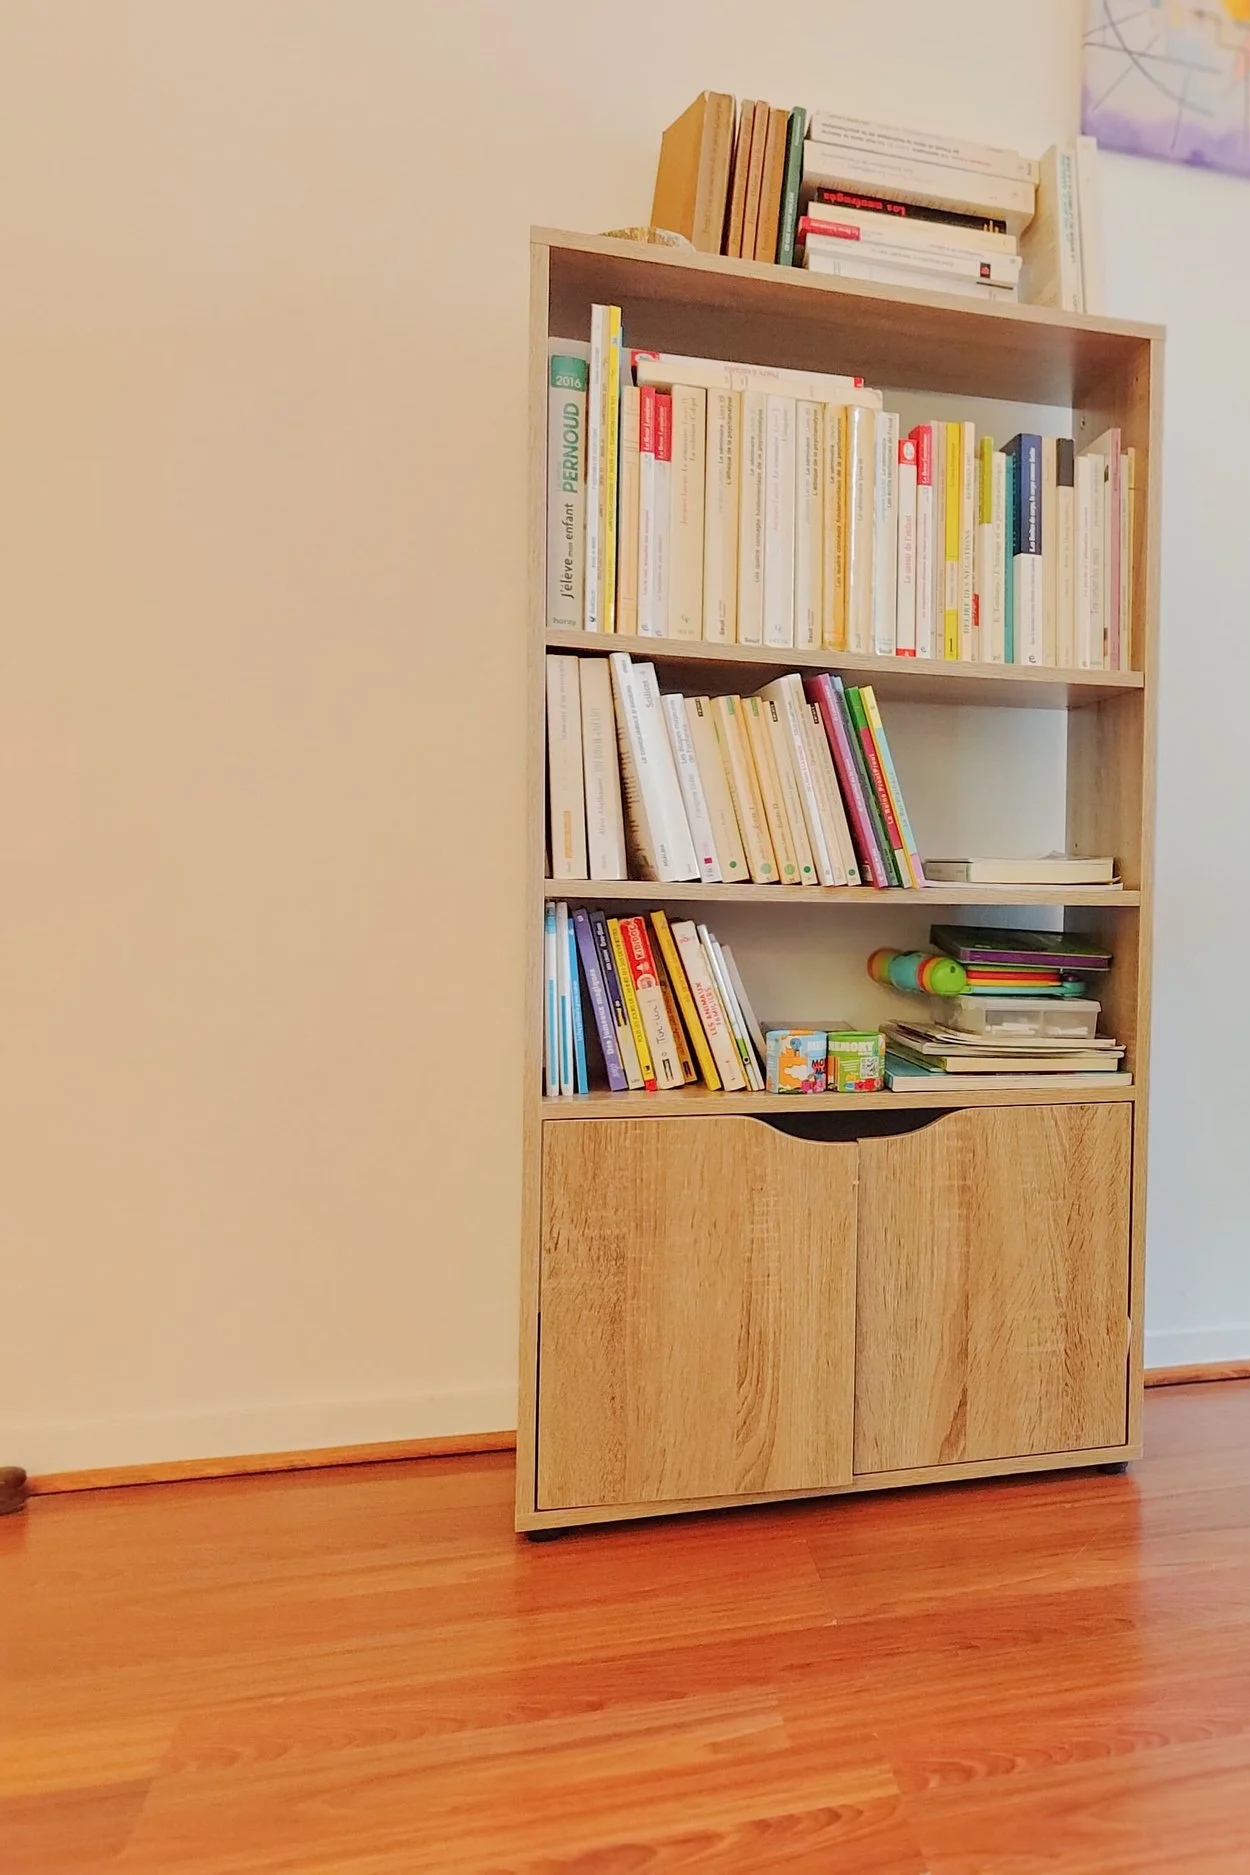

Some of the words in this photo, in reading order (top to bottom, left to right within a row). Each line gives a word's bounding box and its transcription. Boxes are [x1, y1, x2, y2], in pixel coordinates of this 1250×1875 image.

[556, 376, 582, 388] 2016
[561, 401, 579, 493] PERNOUD
[561, 503, 574, 539] enfant
[559, 558, 575, 598] J'élève
[885, 814, 894, 825] La
[587, 967, 604, 1005] magiques
[694, 980, 712, 1020] ANIMAUX
[705, 986, 721, 1025] FAMILIERS
[604, 1039, 614, 1054] Des
[707, 1021, 717, 1035] LES
